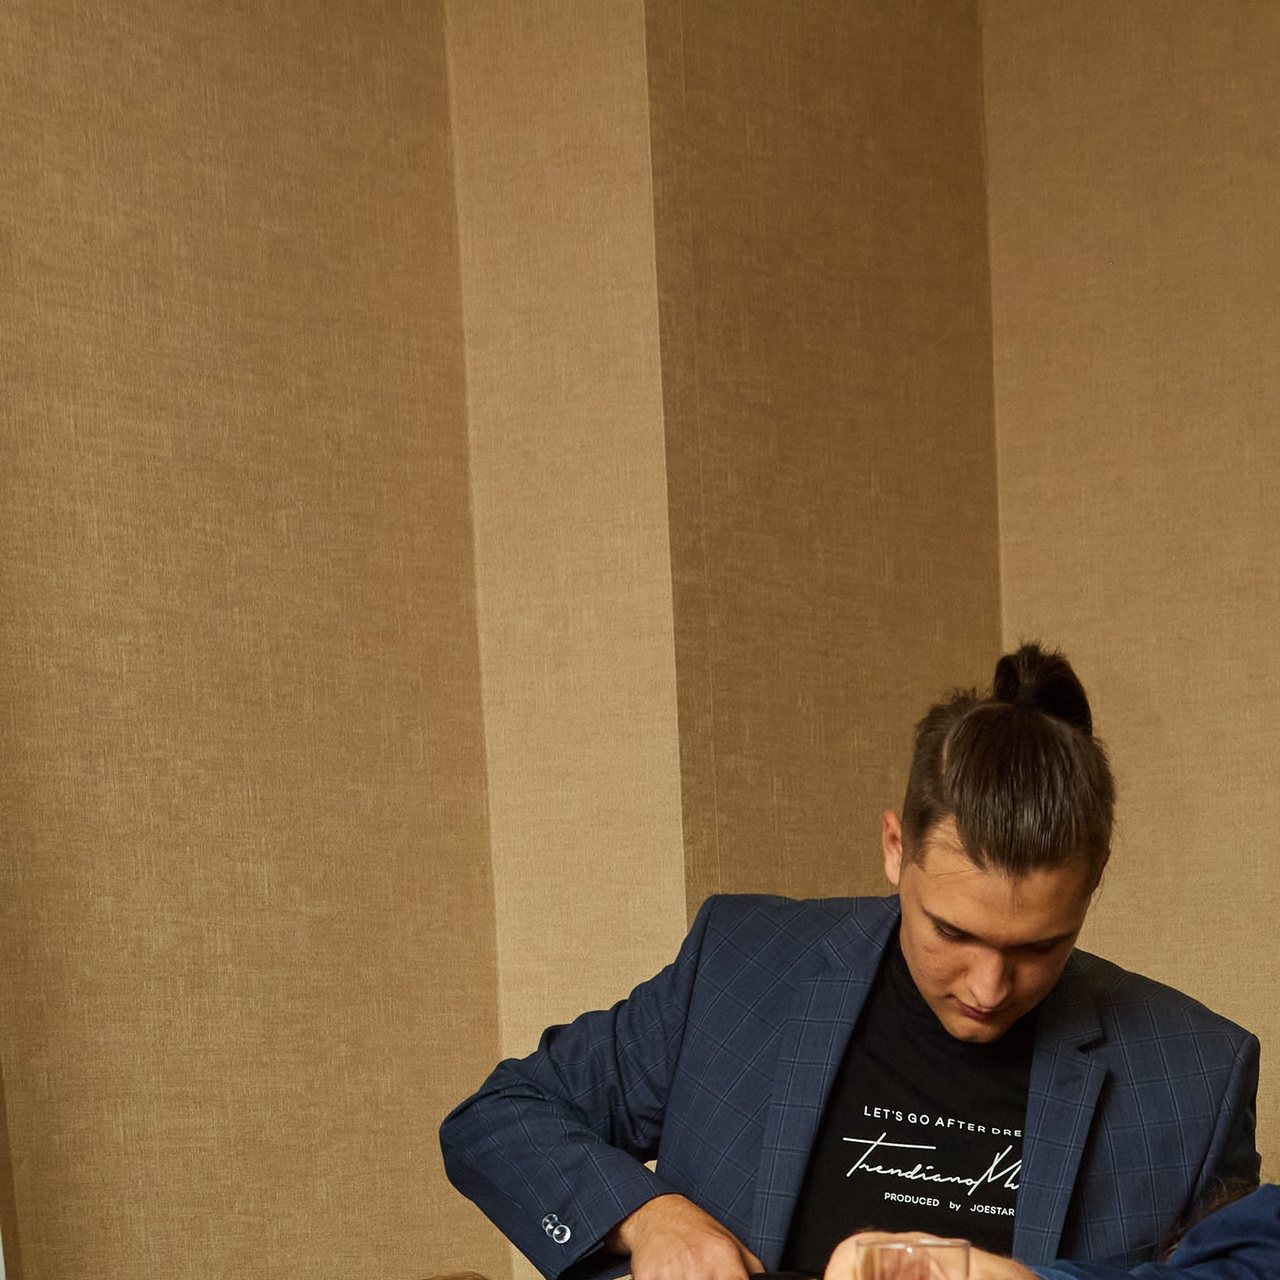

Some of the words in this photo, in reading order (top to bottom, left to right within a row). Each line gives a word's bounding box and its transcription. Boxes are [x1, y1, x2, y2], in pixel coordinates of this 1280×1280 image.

[864, 1105, 903, 1122] LET'S
[908, 1112, 930, 1125] GO
[934, 1116, 986, 1133] AFTER
[991, 1127, 1022, 1138] DRE
[884, 1191, 940, 1207] PRODUCED
[949, 1201, 961, 1211] by
